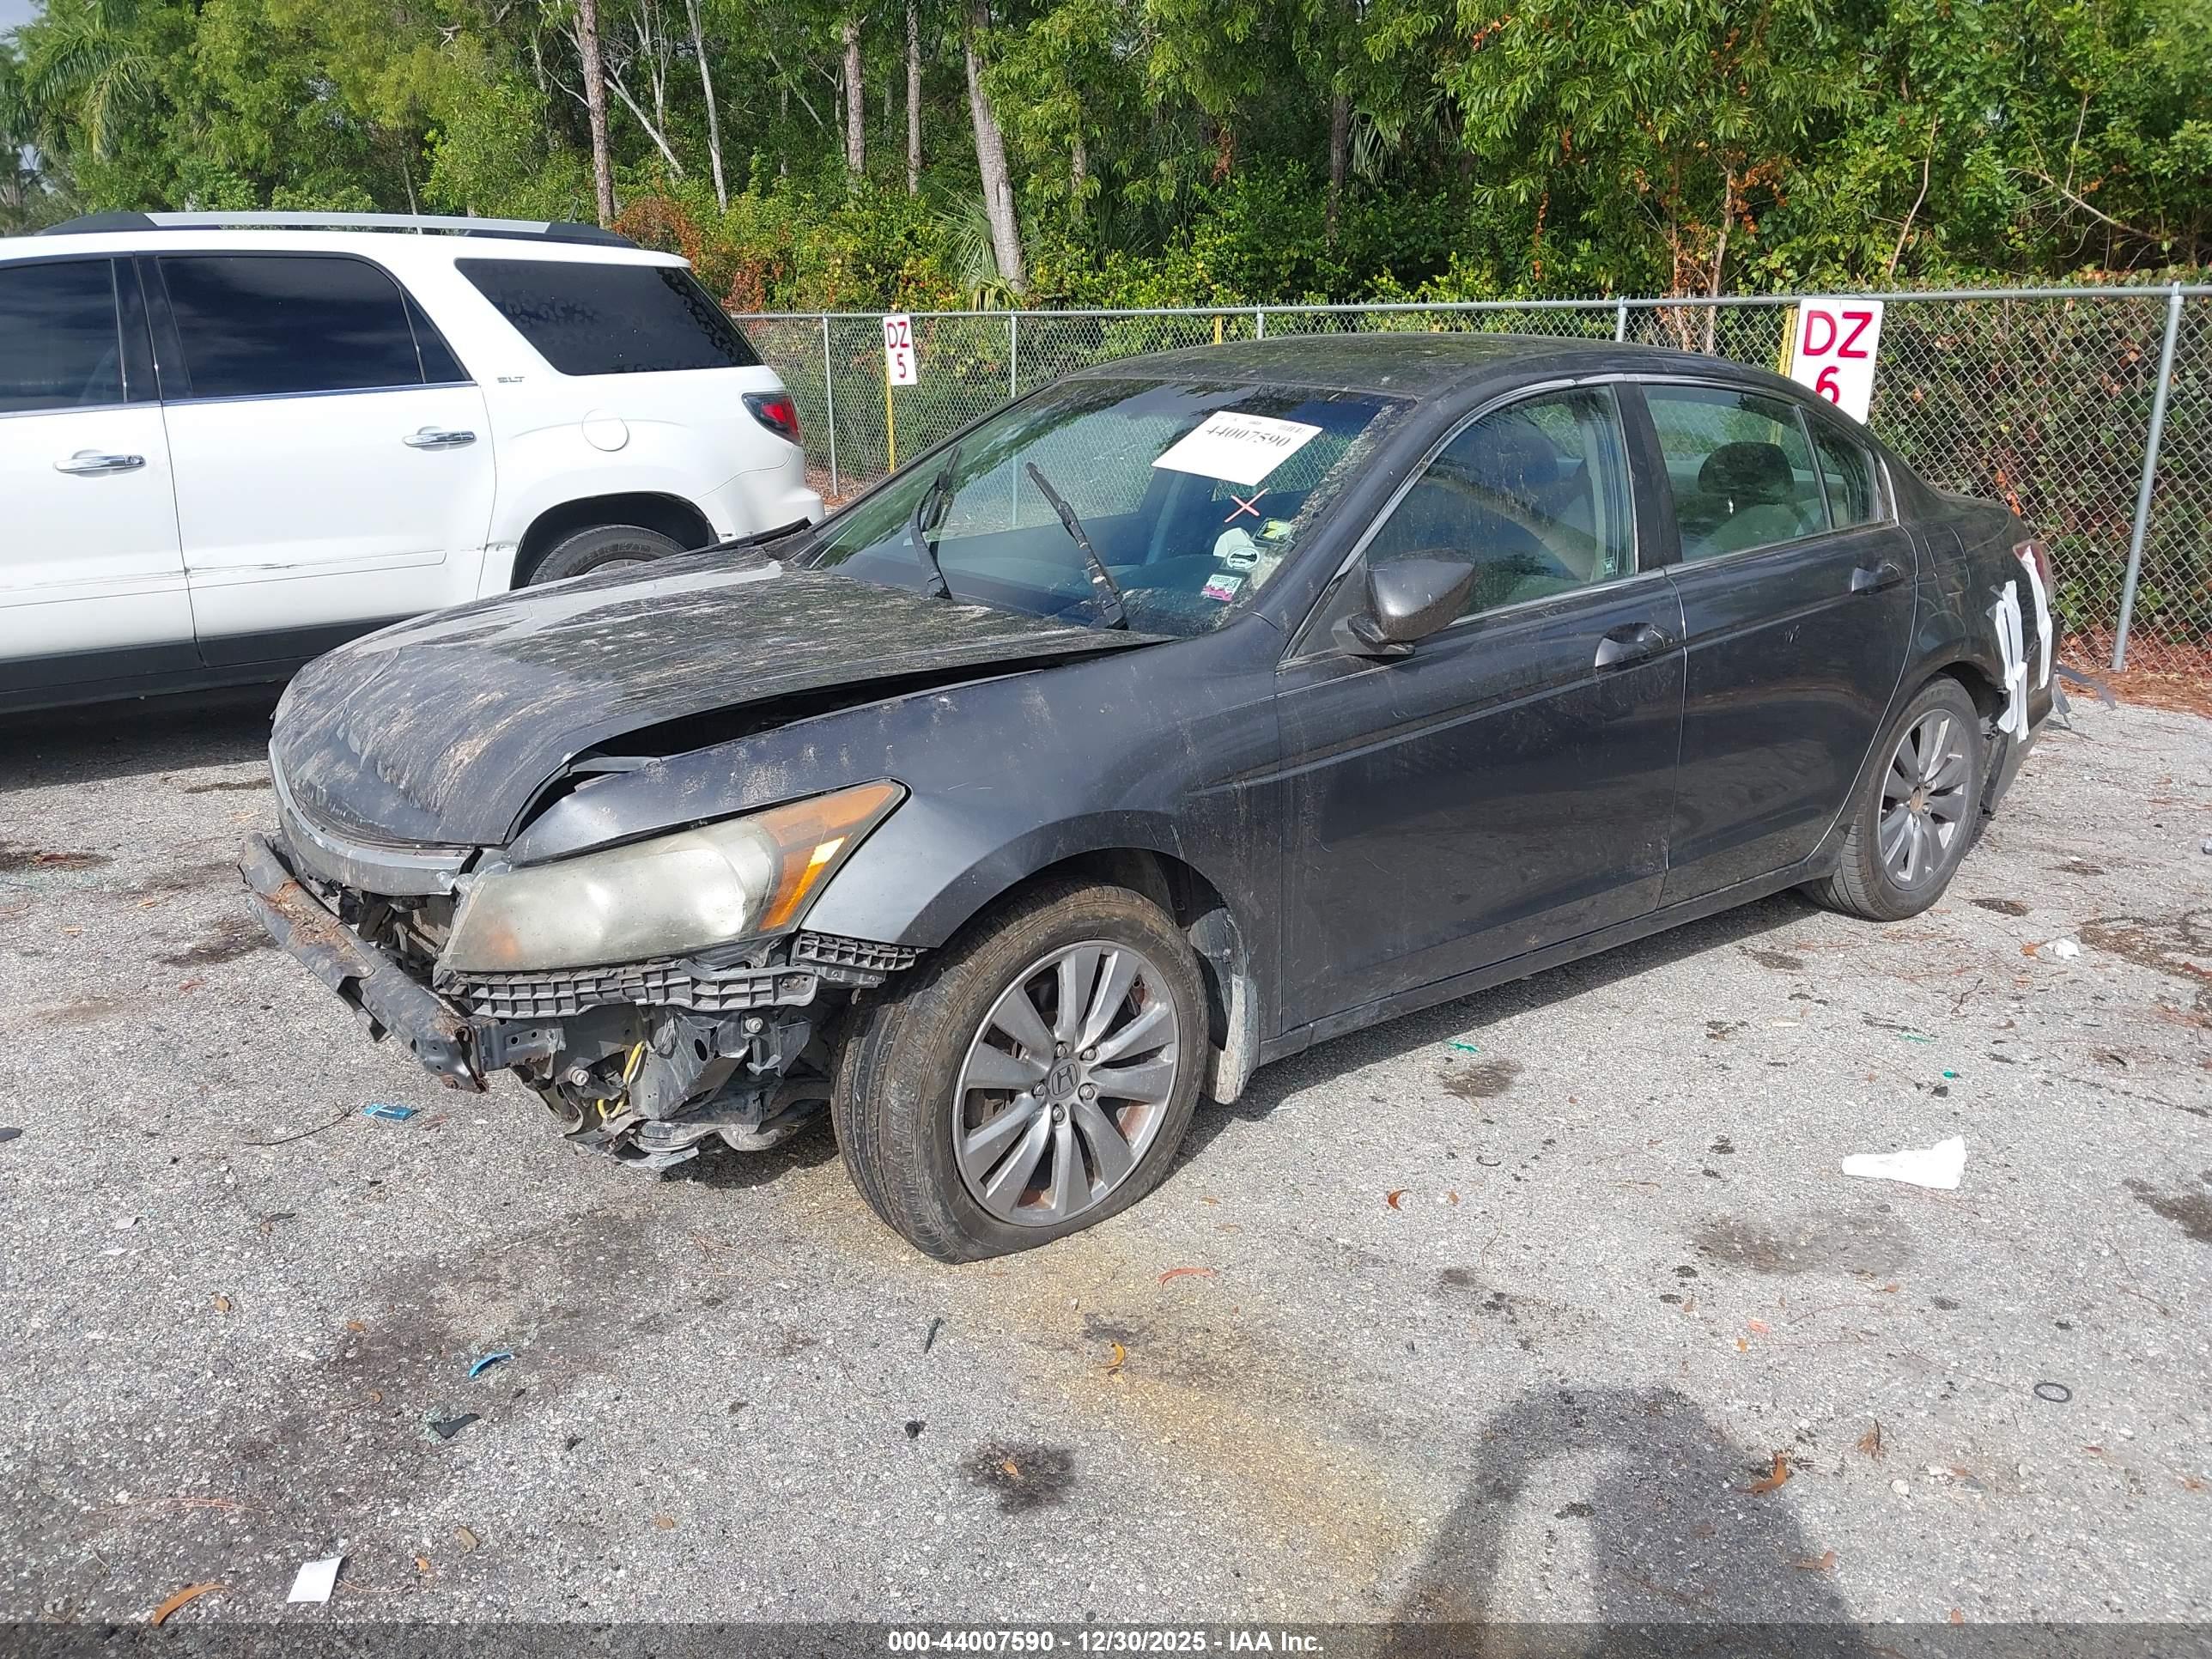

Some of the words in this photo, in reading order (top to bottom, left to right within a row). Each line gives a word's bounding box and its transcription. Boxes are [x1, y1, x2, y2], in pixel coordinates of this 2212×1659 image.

[886, 321, 909, 349] DZ
[1803, 310, 1874, 358] DZ
[896, 353, 907, 378] 5
[1815, 366, 1840, 404] 6
[1206, 425, 1291, 447] 44007590
